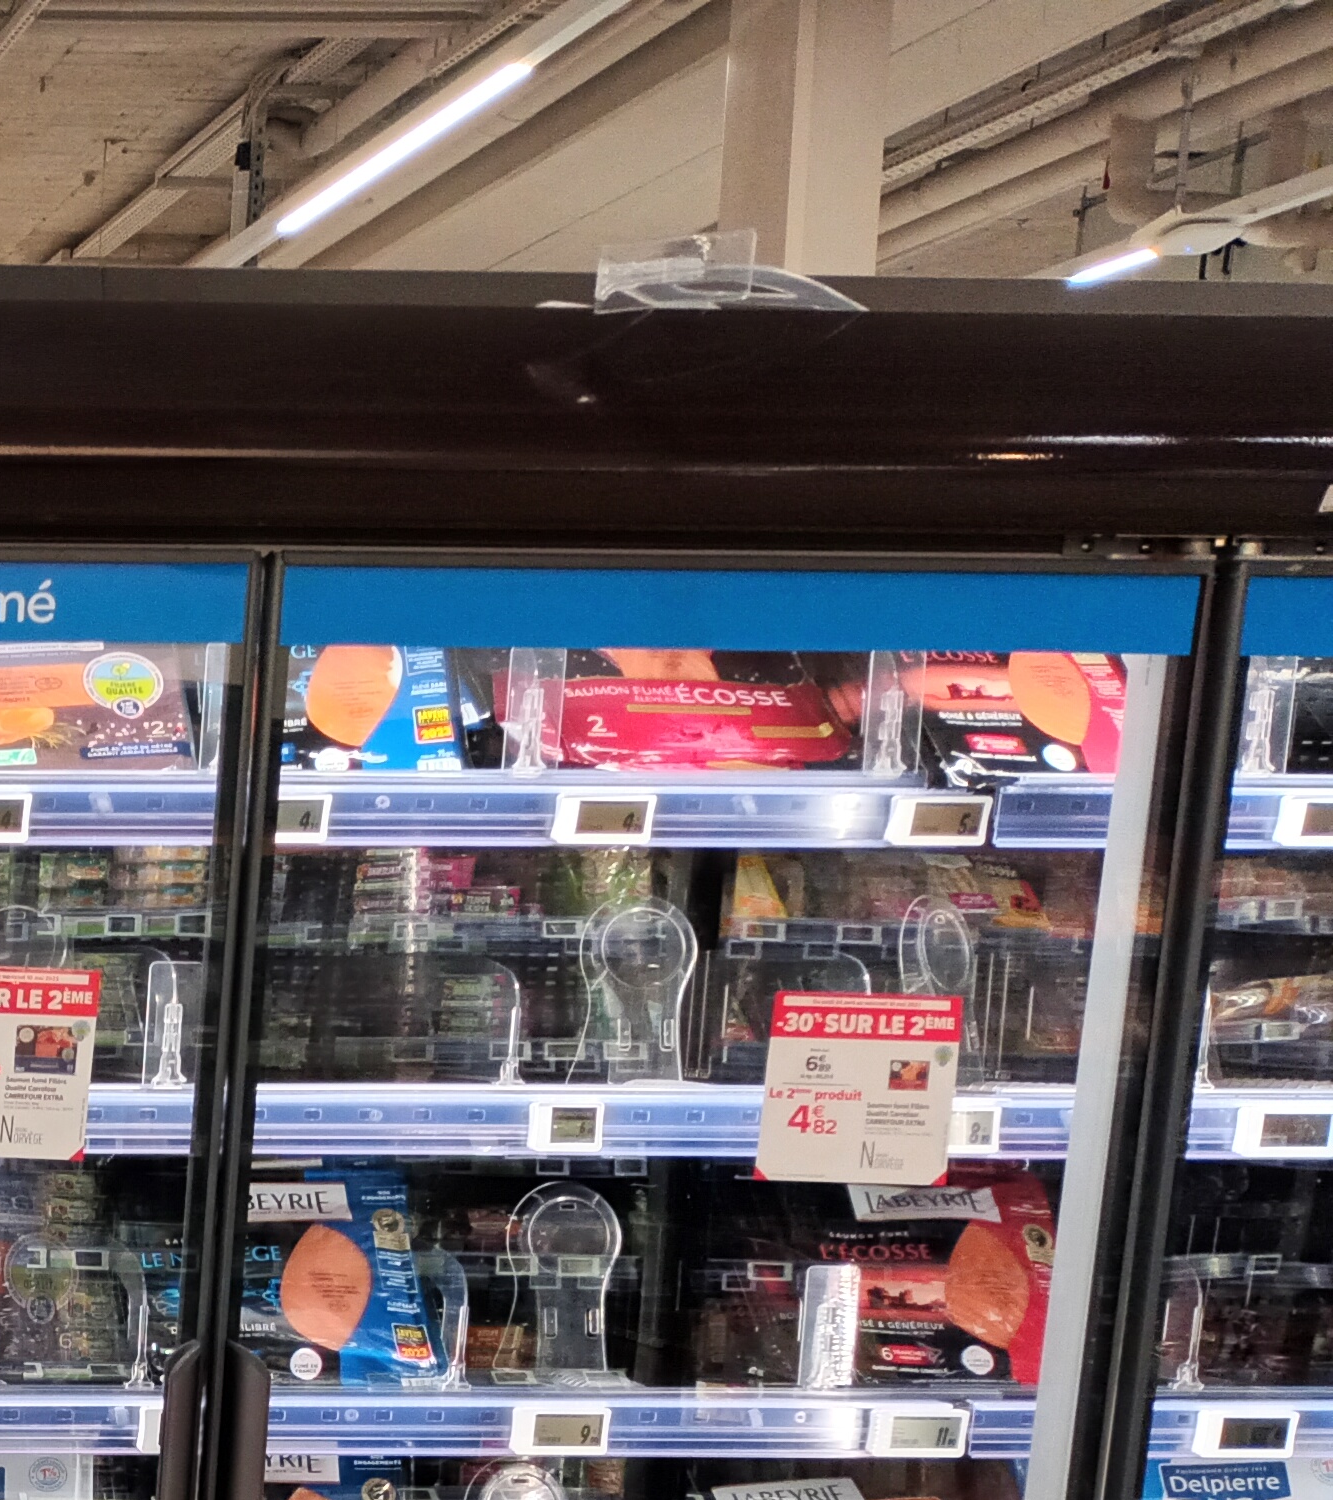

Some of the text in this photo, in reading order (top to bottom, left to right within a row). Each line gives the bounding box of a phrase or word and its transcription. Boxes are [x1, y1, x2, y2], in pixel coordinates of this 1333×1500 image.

[564, 685, 630, 699] SAUMON
[675, 682, 793, 707] ÉCOSSE
[150, 720, 166, 736] 2
[587, 715, 608, 733] 2
[16, 989, 43, 1009] LE
[47, 988, 93, 1010] 2ÈME
[823, 1014, 873, 1034] SUR
[878, 1016, 905, 1035] LE
[910, 1014, 955, 1036] 2ÈME
[769, 1087, 783, 1099] Le
[815, 1089, 862, 1102] produit
[1169, 1475, 1280, 1495] Delpierre
